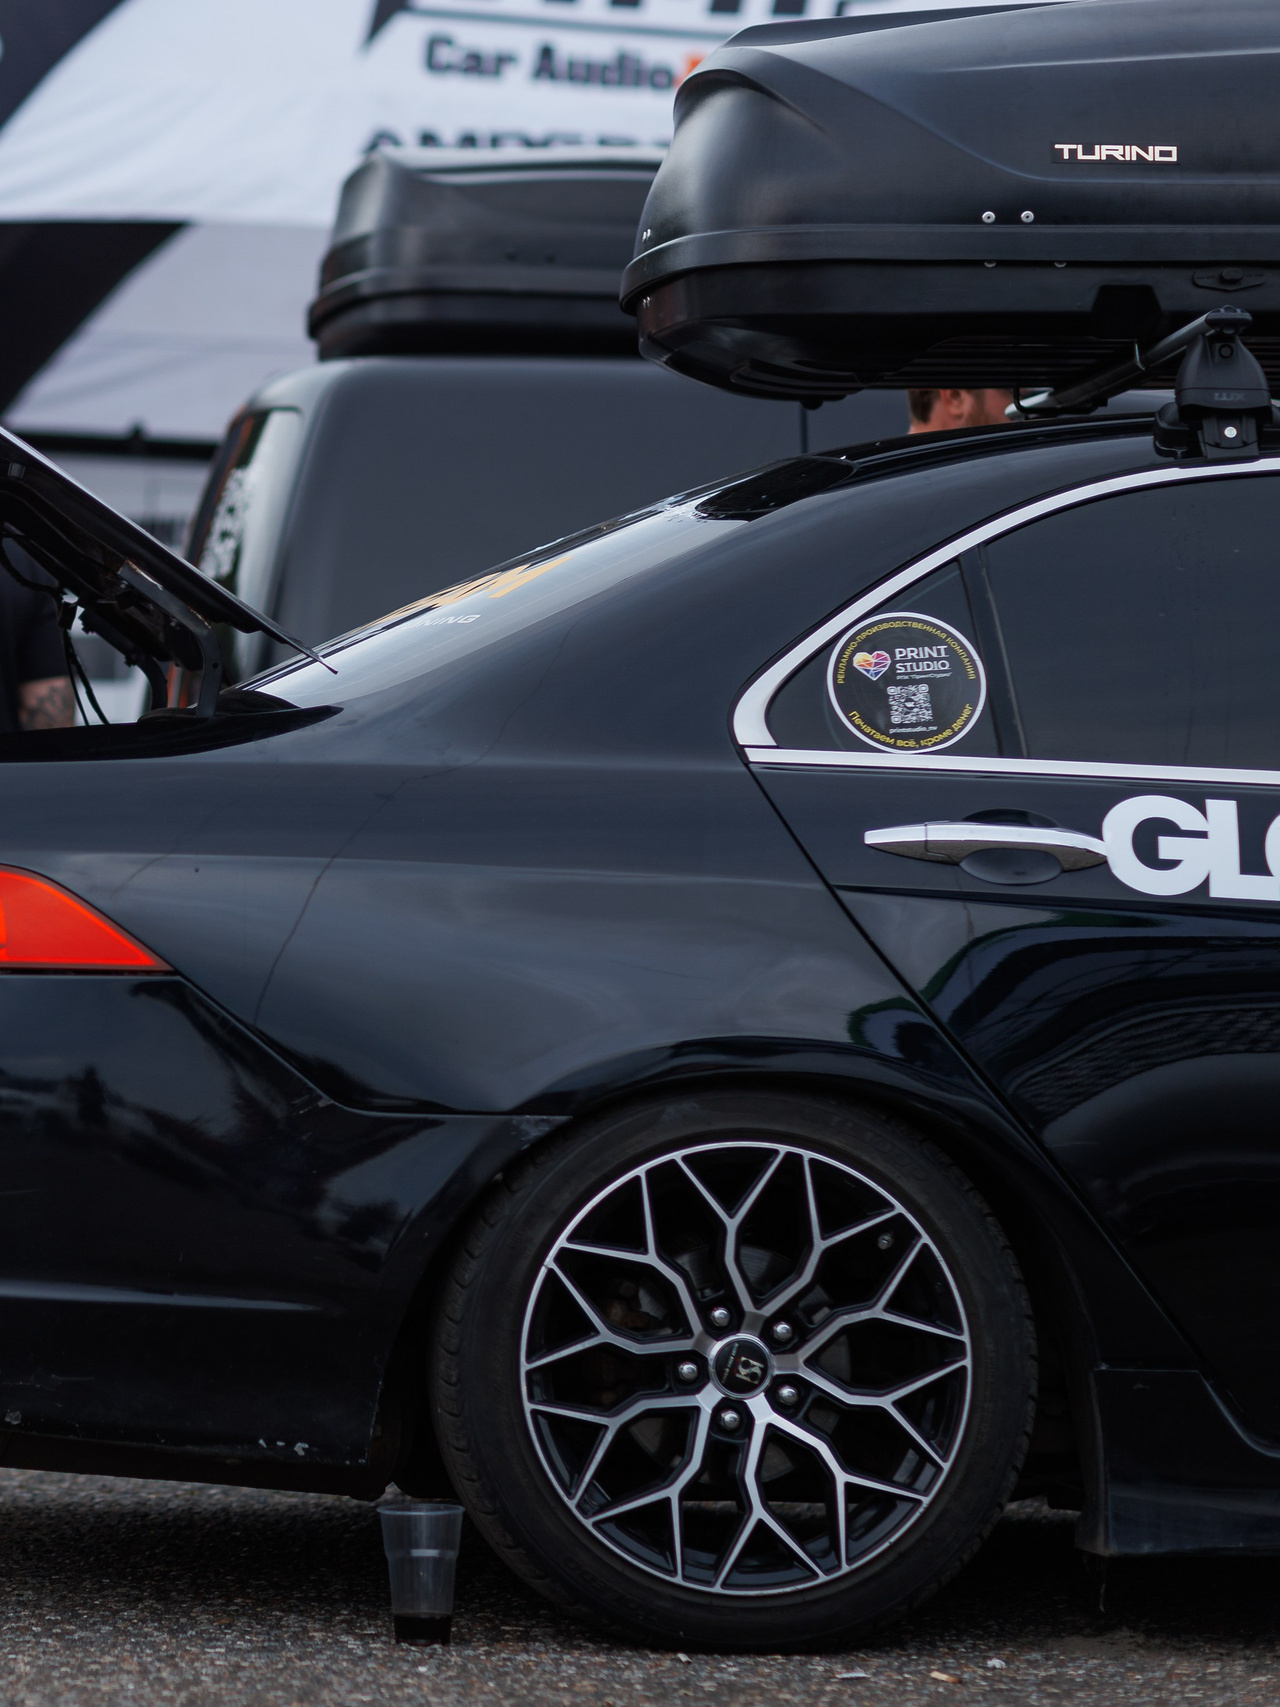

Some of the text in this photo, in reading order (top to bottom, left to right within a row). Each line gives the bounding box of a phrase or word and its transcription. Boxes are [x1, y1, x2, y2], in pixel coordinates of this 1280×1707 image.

[425, 34, 675, 89] Car Audio
[1054, 143, 1178, 162] TURINO
[836, 620, 976, 684] РЕКЛАМНО-ПРОИЗВОДСТВЕННАЯ КОМПАНИЯ
[894, 645, 949, 660] PRINT
[895, 659, 951, 673] STUDIO
[848, 710, 895, 746] Печатаем
[920, 728, 953, 747] кроме
[952, 703, 973, 733] денег
